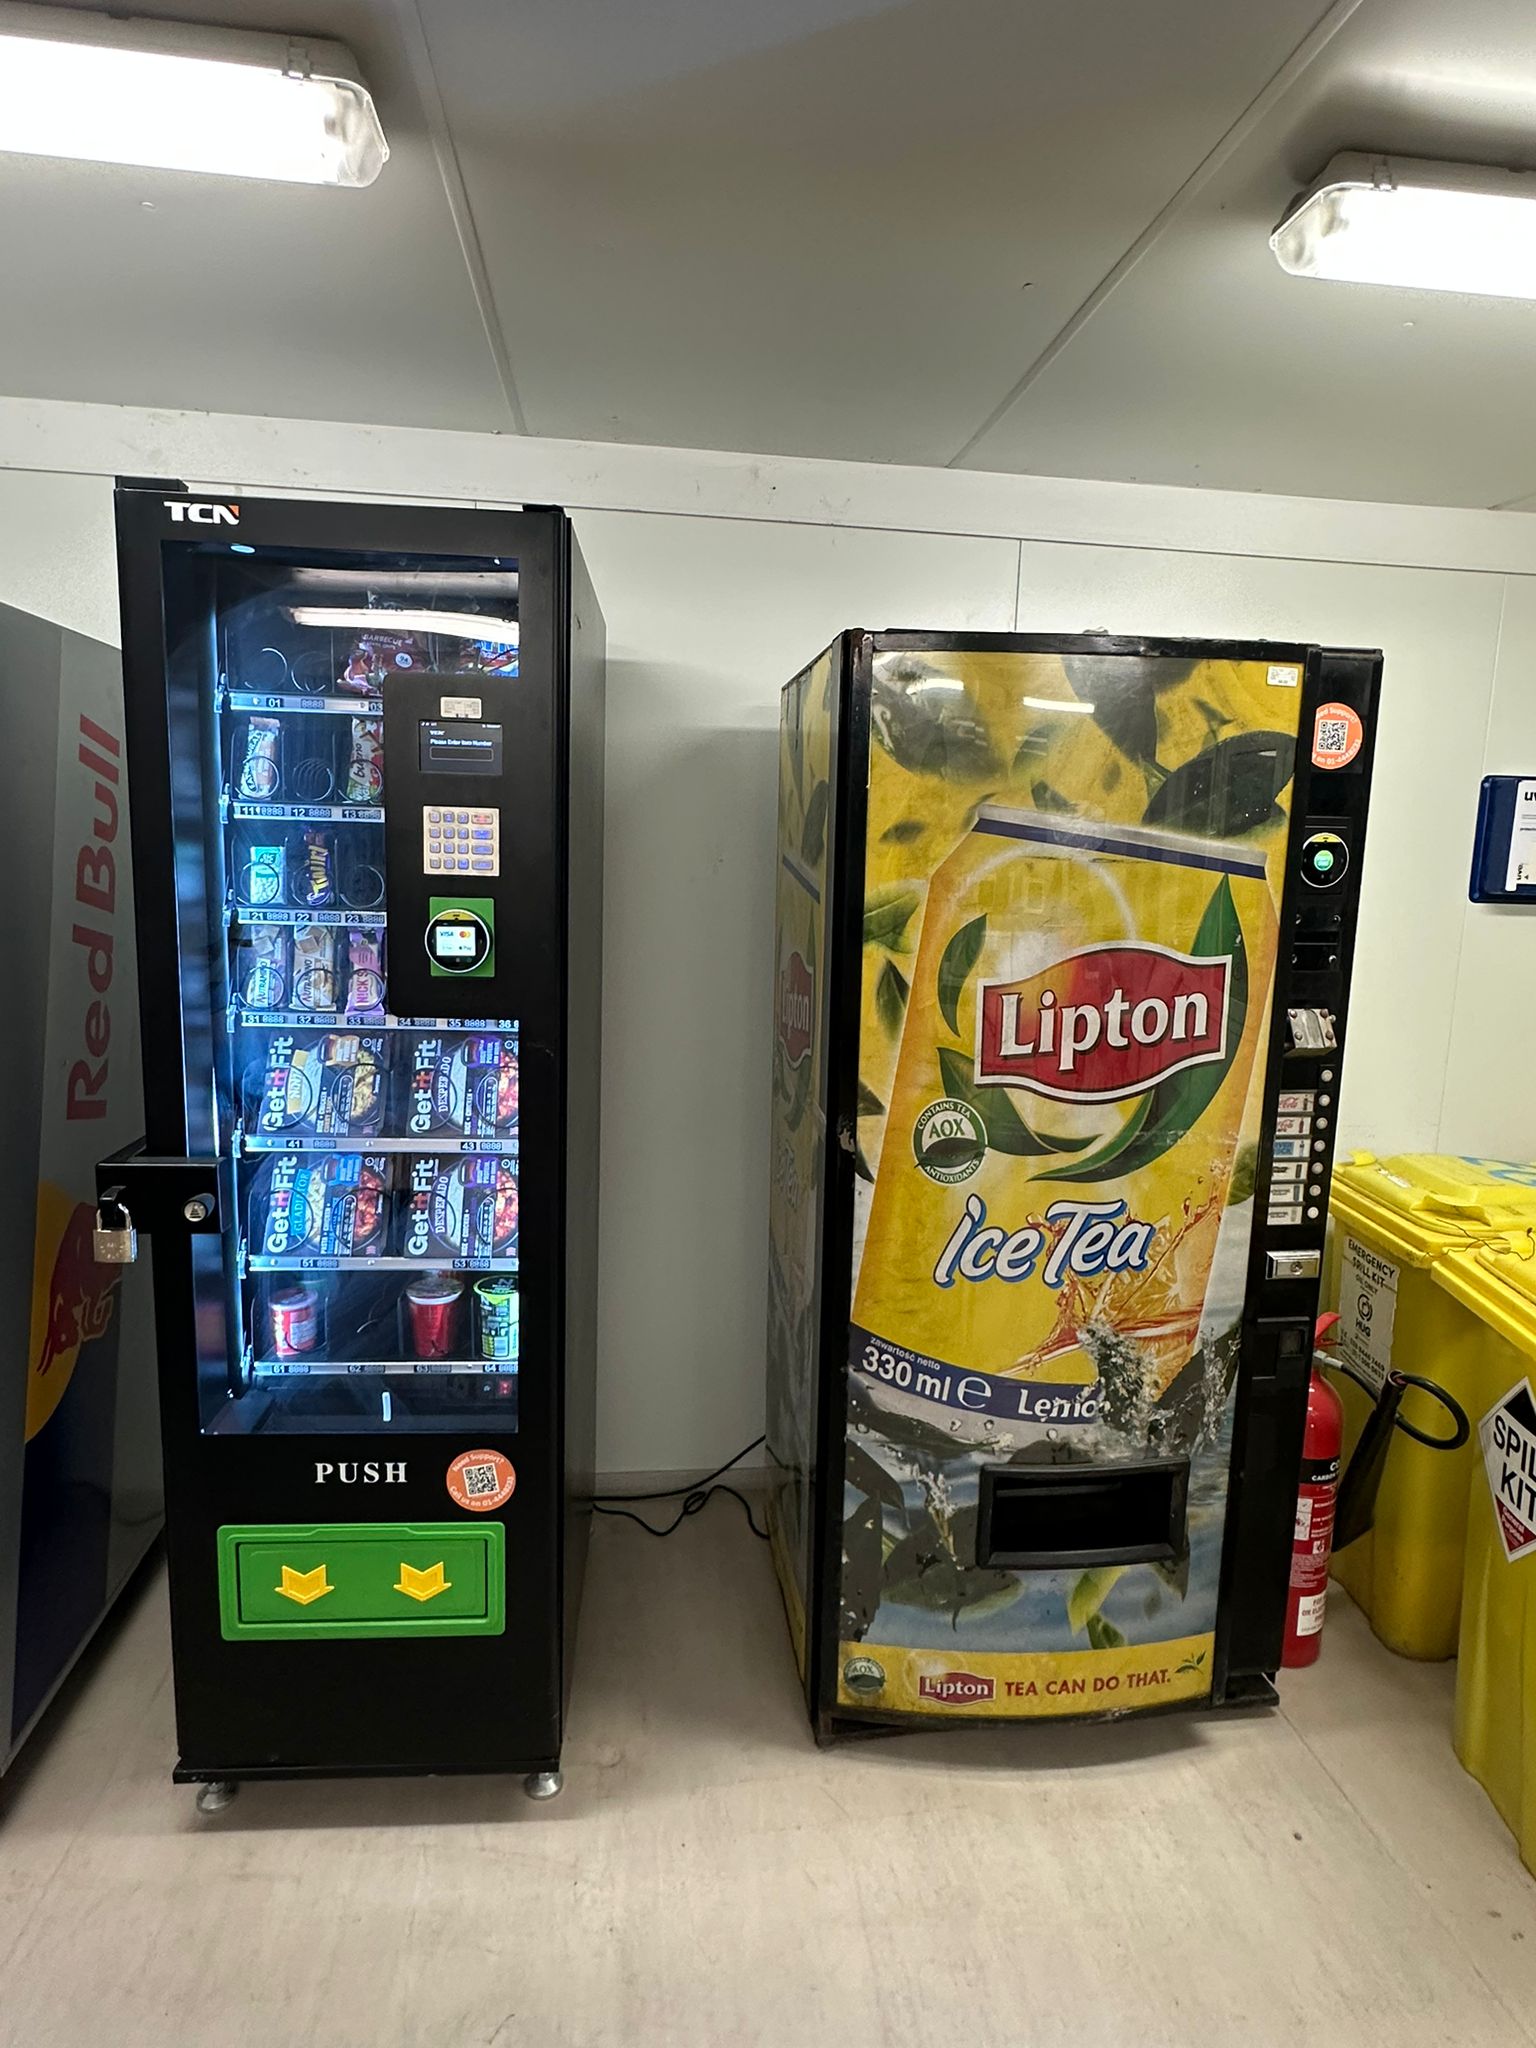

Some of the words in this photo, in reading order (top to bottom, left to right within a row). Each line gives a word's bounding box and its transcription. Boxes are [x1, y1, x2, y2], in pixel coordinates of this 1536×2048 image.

[163, 501, 240, 525] TCN
[268, 699, 282, 708] 01
[353, 743, 366, 778] bueno
[75, 713, 121, 914] Bull
[291, 808, 306, 817] 12
[251, 912, 264, 920] 21
[296, 913, 310, 922] 22
[346, 915, 360, 923] 23
[66, 923, 114, 1120] Red
[448, 1019, 461, 1027] 35
[499, 1020, 511, 1029] 36
[999, 988, 1210, 1072] Lipton
[917, 1102, 954, 1130] CONTAINS
[957, 1104, 971, 1118] TEA
[929, 1118, 965, 1139] AOX
[462, 1141, 475, 1149] 43
[925, 1159, 979, 1183] ANTIOXIDANTS
[1042, 1199, 1156, 1289] Tea
[1348, 1238, 1396, 1279] EMERGENCY
[1372, 1271, 1385, 1288] KIT
[862, 1346, 912, 1387] 330
[915, 1372, 950, 1402] ml
[917, 1357, 941, 1370] netto
[314, 1462, 408, 1483] PUSH
[1501, 1462, 1536, 1522] KIT
[924, 1678, 989, 1699] Lipton
[1005, 1681, 1038, 1697] TEA
[1045, 1679, 1086, 1696] CAN
[1093, 1675, 1120, 1692] DO
[1127, 1669, 1172, 1688] THAT.
